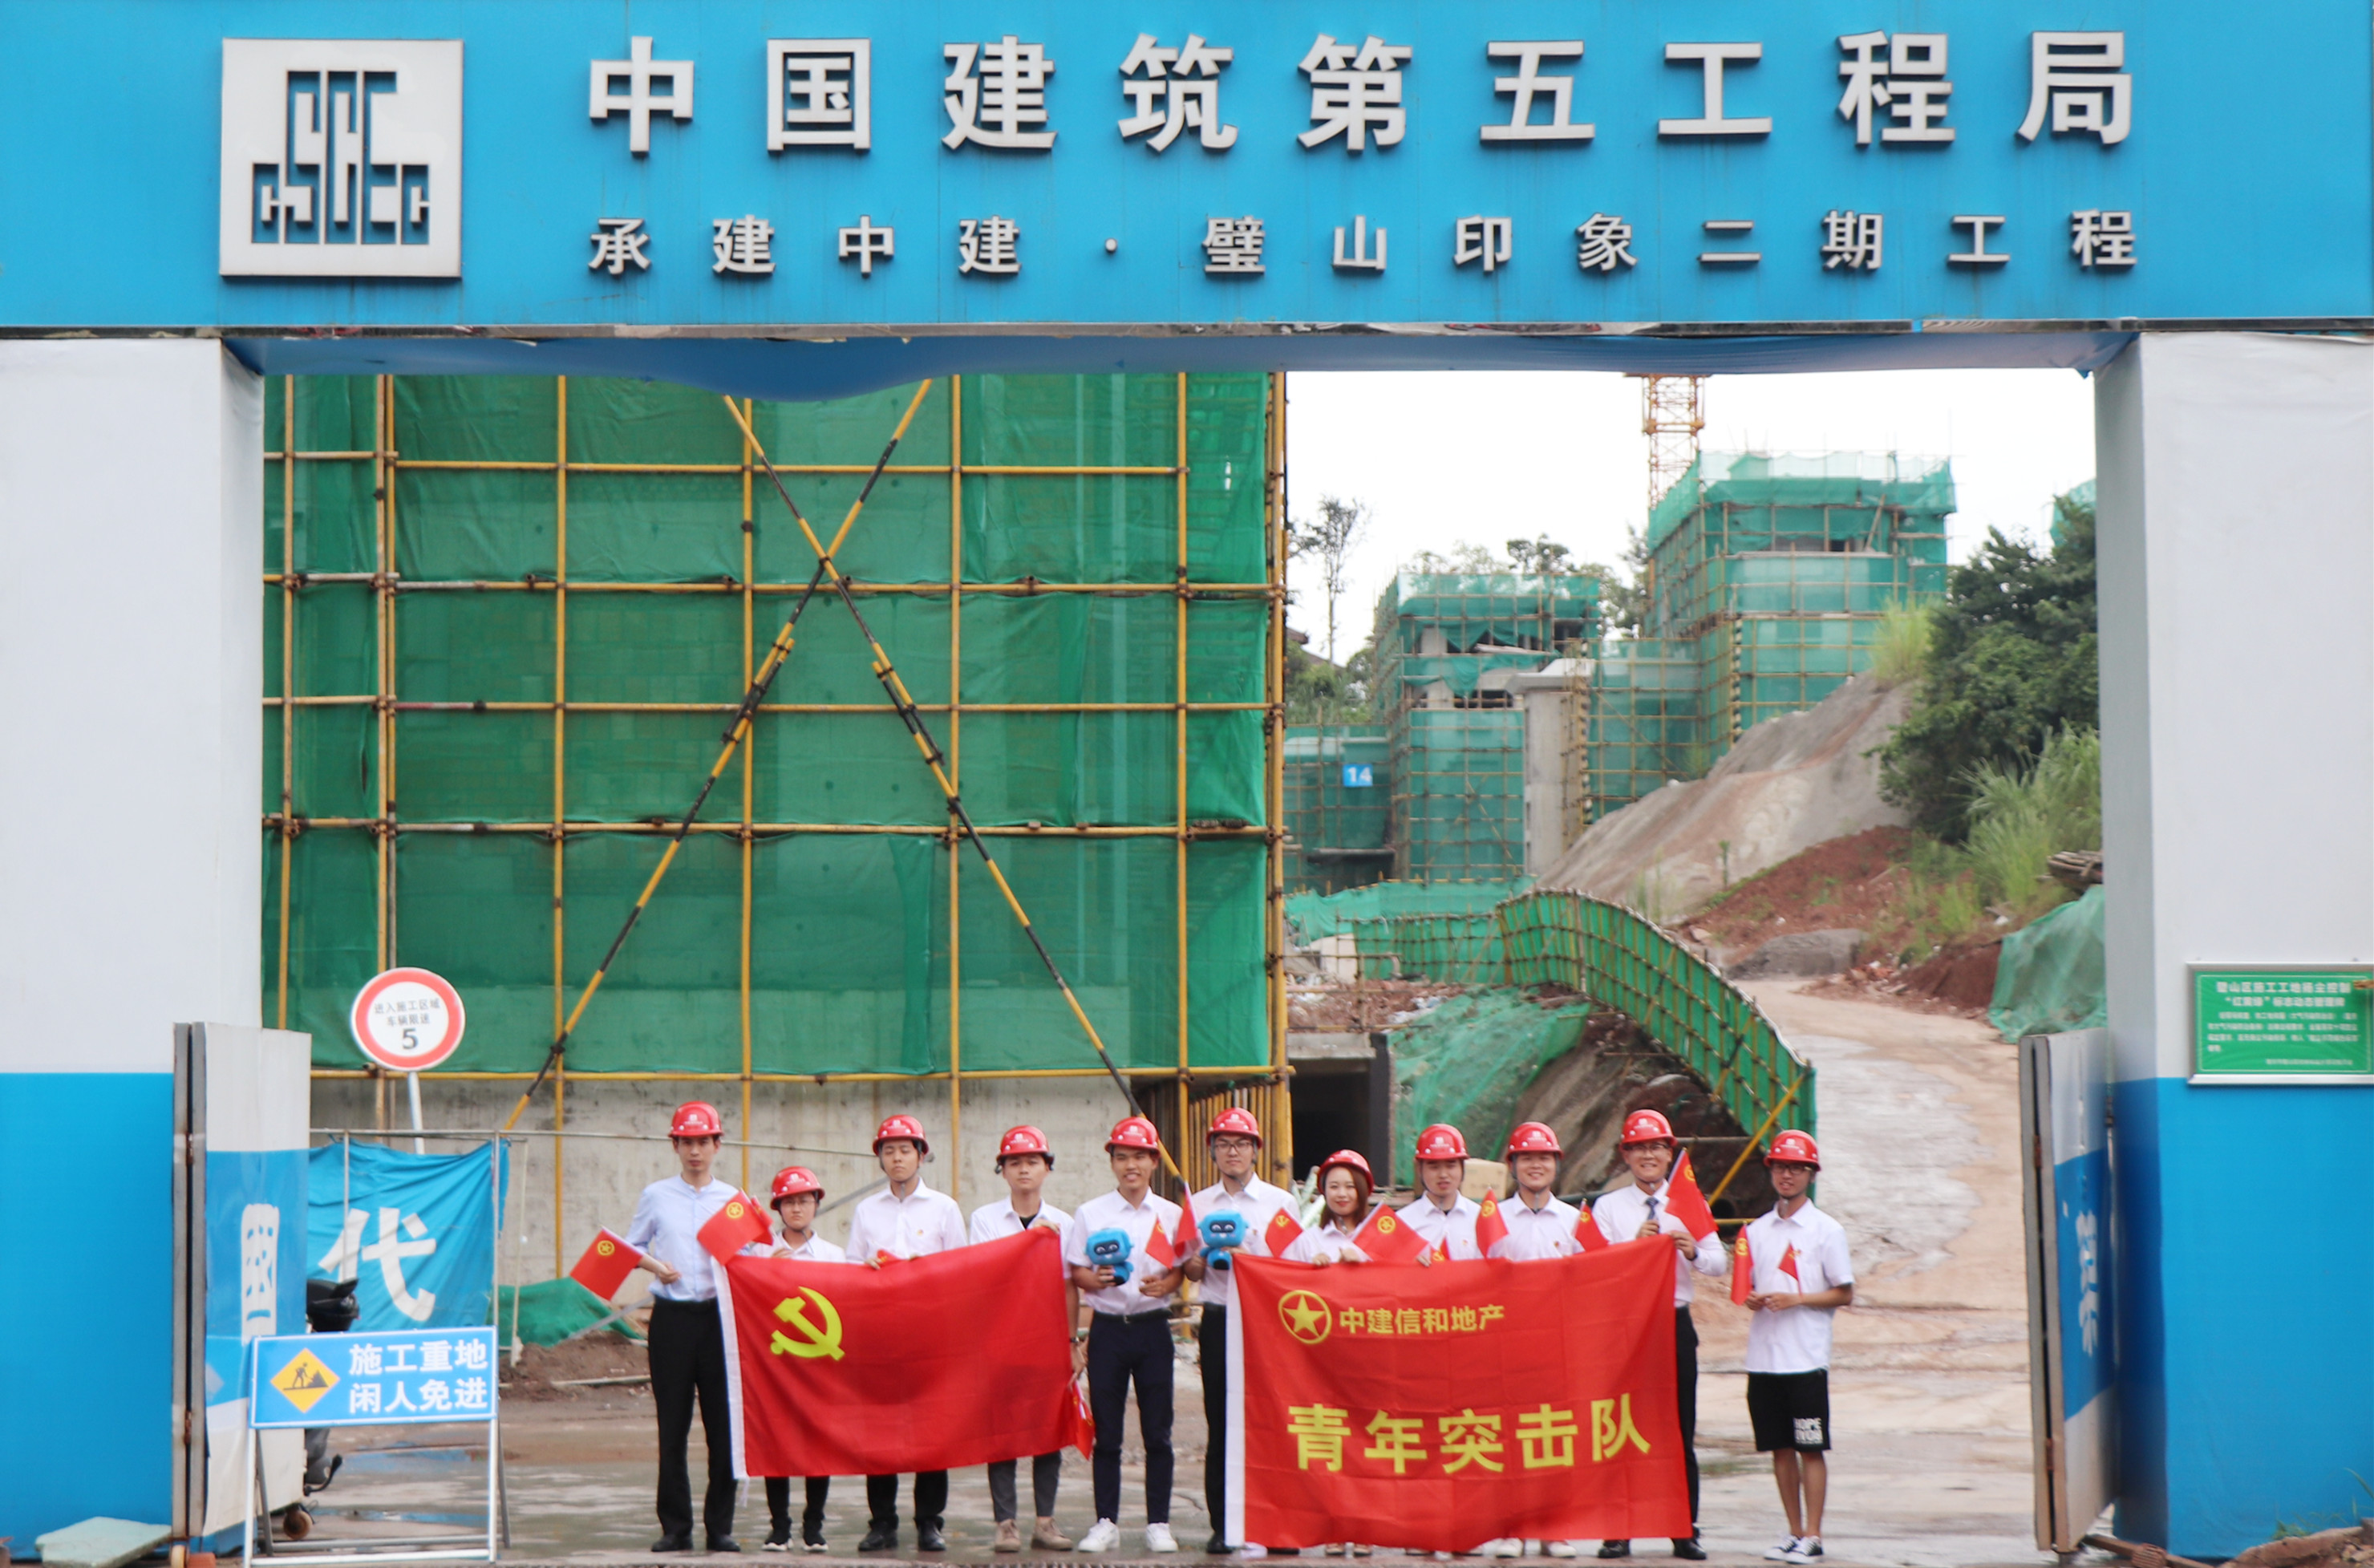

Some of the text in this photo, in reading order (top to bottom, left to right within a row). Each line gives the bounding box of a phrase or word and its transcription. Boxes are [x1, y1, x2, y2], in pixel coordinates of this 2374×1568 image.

[589, 30, 2133, 152] 中国建筑第五工程局
[1347, 767, 1372, 783] 14
[374, 997, 440, 1015] 进入施工区域
[387, 1012, 430, 1027] 车辆限速
[402, 1027, 419, 1050] 5
[318, 1206, 437, 1322] 代
[1339, 1303, 1505, 1336] 中建信和地产
[348, 1338, 489, 1376] 施工重地
[348, 1376, 488, 1415] 闲人免进
[1286, 1392, 1652, 1475] 青年突击队
